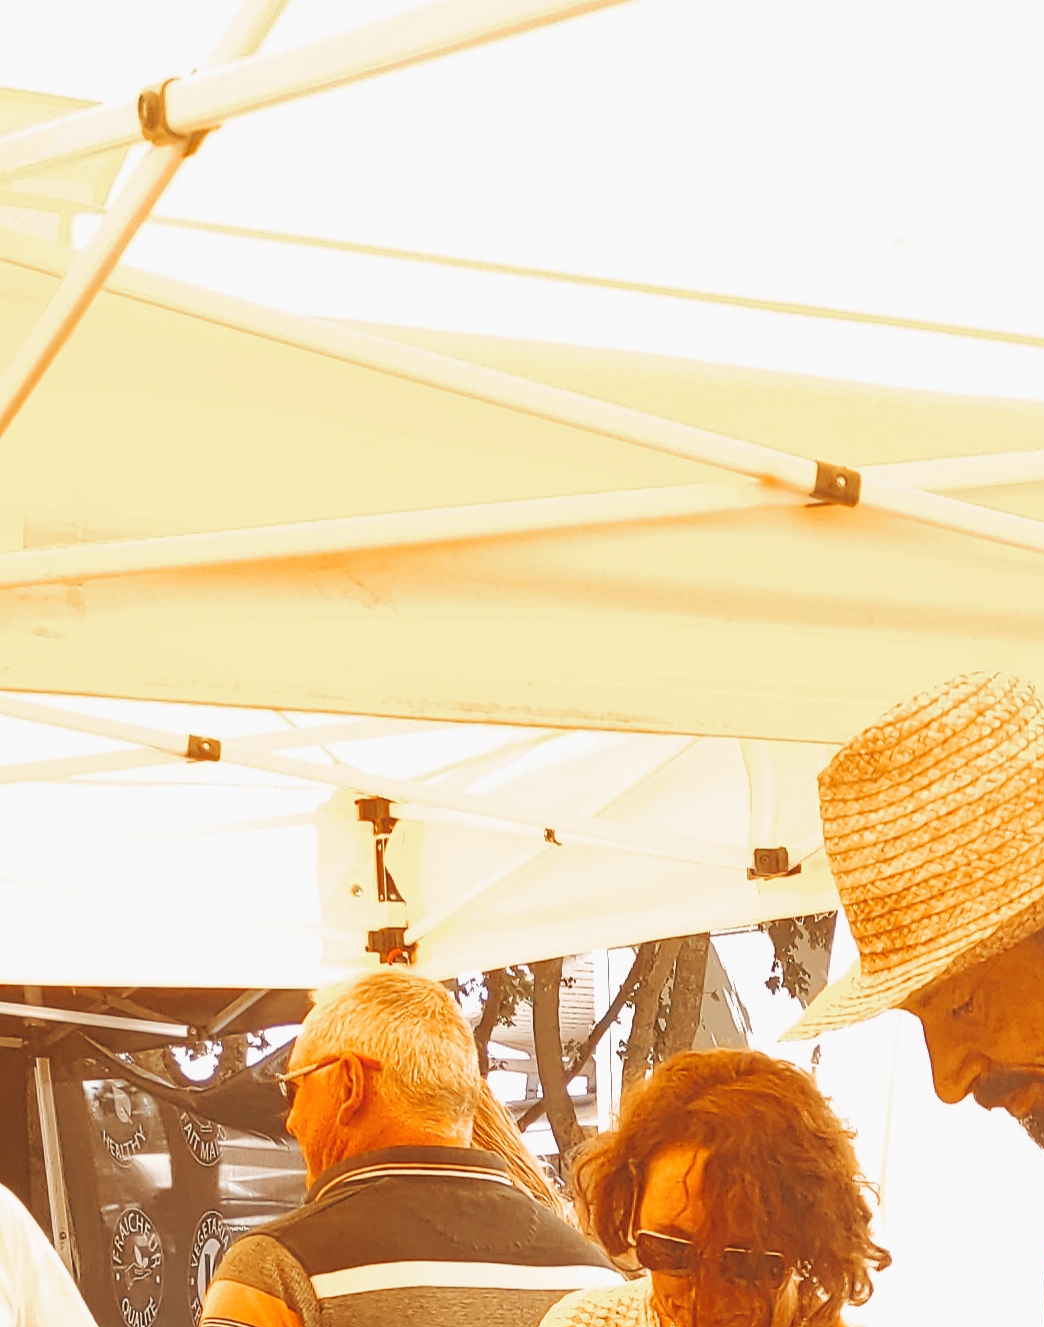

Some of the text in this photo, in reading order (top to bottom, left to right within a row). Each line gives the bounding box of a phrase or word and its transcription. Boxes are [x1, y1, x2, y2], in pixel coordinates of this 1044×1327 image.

[102, 1124, 146, 1161] HEALTHY
[180, 1111, 200, 1151] FAIT
[191, 1218, 230, 1267] VEGETARIA
